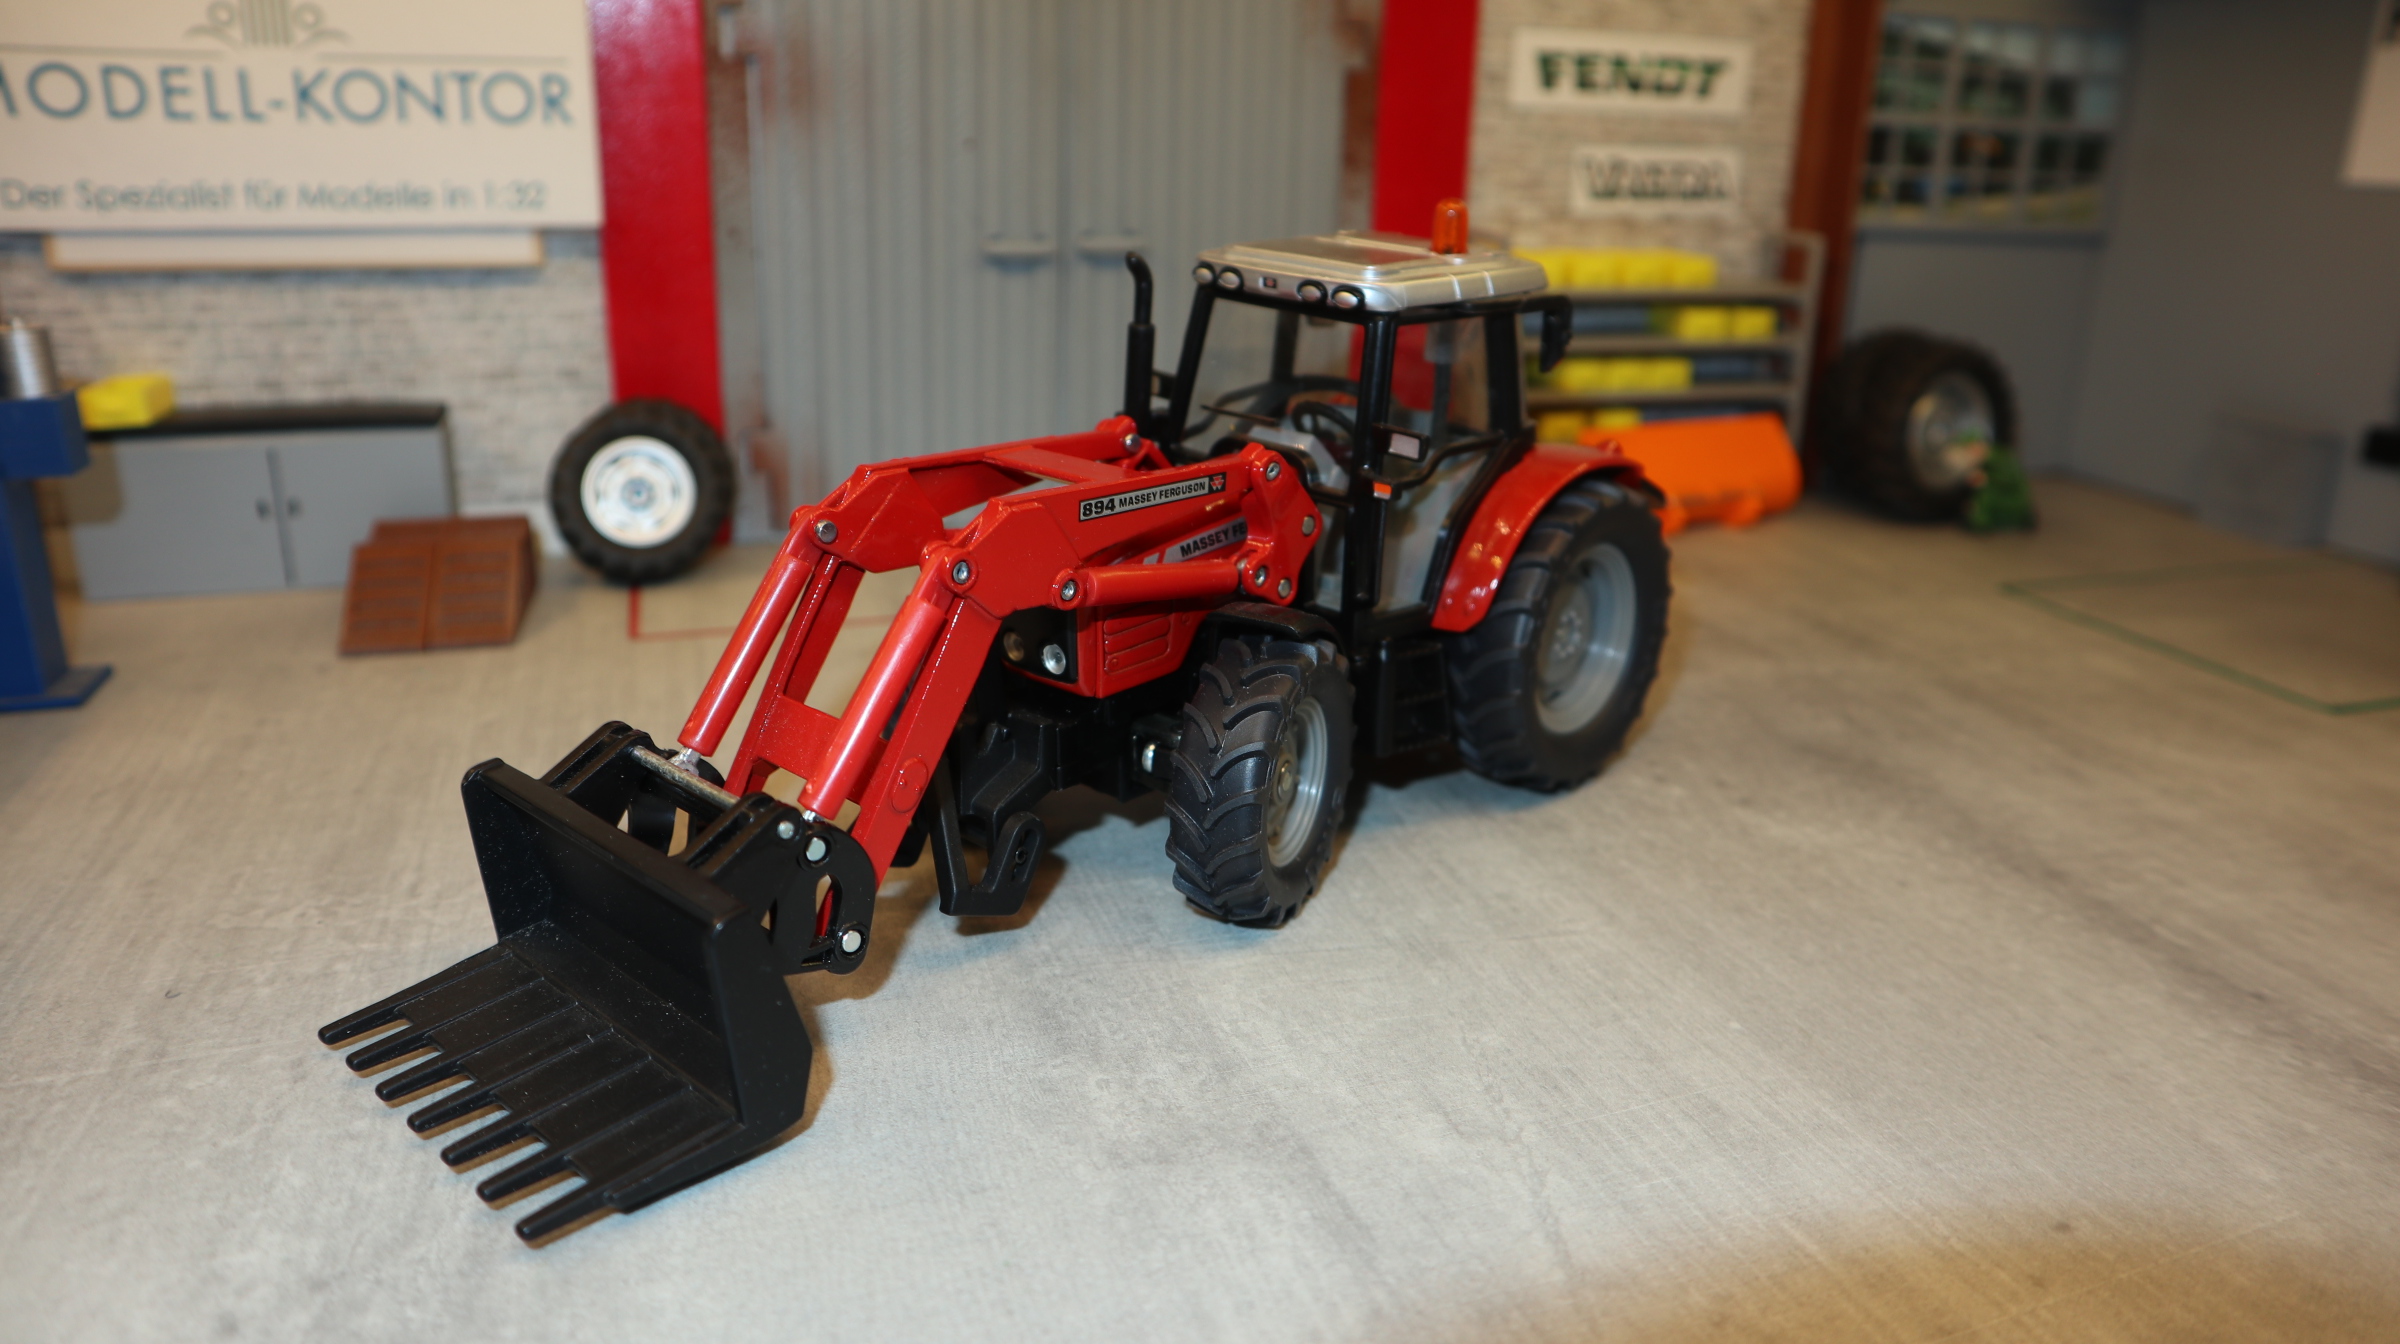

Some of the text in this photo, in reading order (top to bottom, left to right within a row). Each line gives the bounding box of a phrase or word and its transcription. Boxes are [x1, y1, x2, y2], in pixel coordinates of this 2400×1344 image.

[1537, 51, 1727, 98] FENDT
[0, 178, 546, 213] Der Spezialist für Modelle in 1:32
[1082, 481, 1206, 517] 894 MASSEY FERGUSON
[1180, 528, 1230, 558] MASSEY
